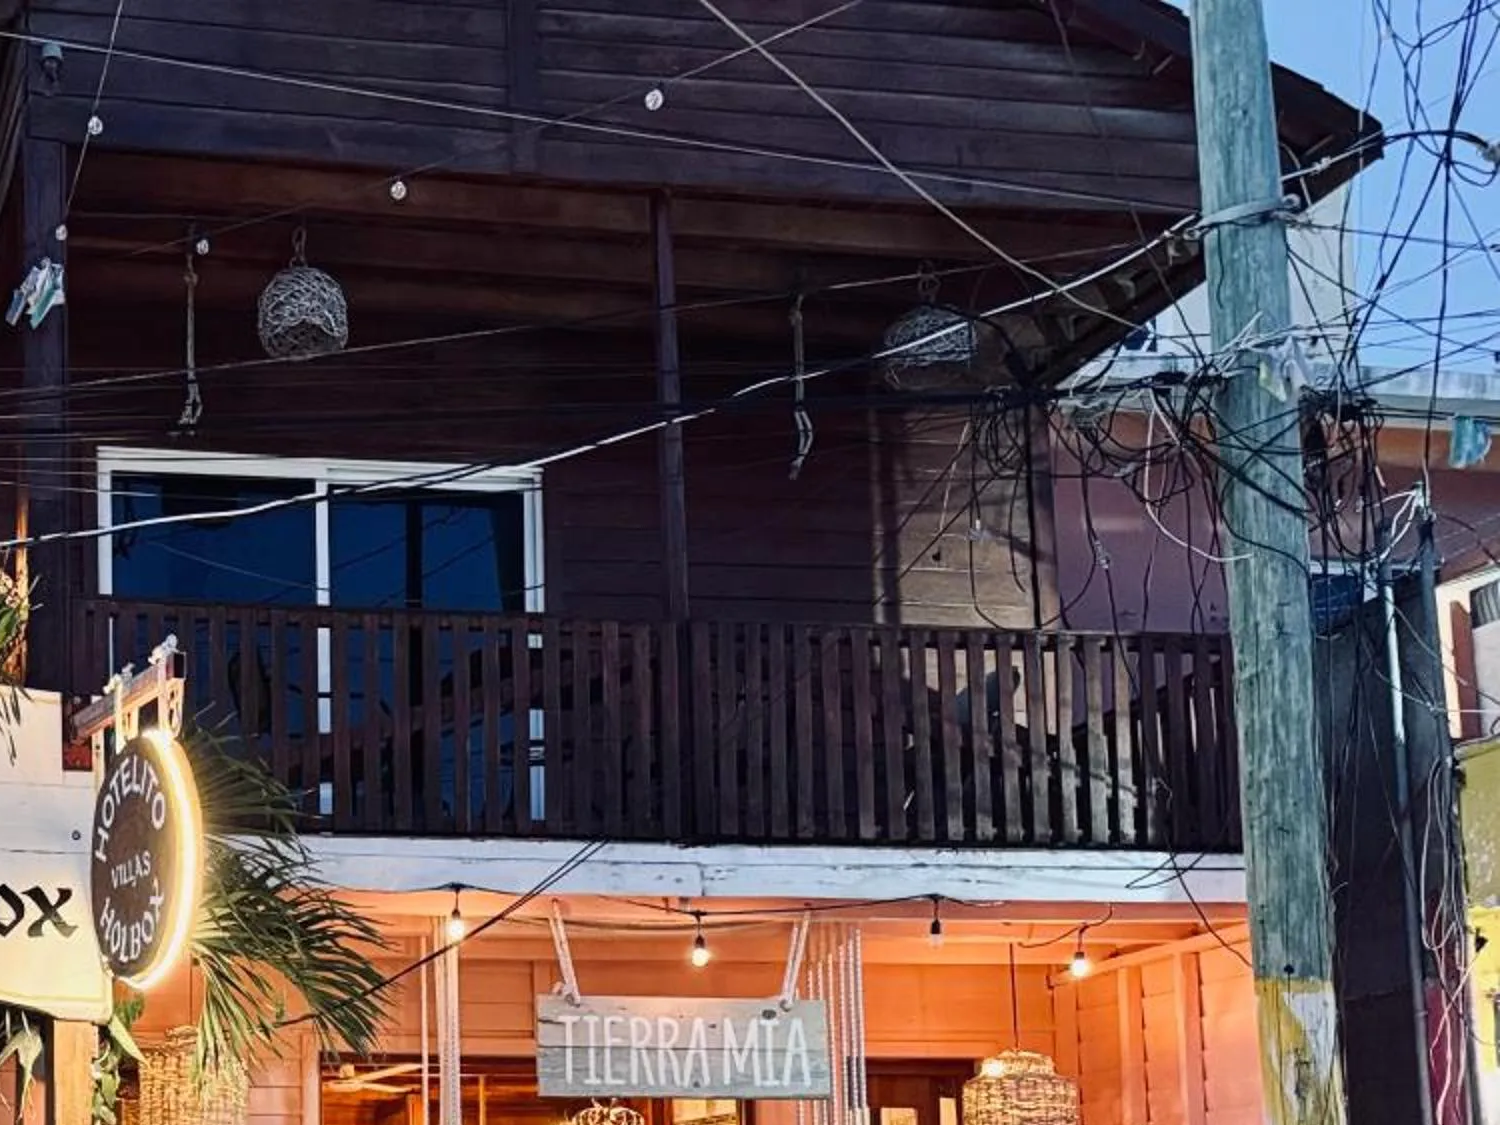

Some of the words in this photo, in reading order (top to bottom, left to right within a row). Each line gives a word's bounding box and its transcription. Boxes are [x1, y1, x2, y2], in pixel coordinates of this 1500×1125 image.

[94, 754, 166, 863] HOTELITO
[111, 850, 152, 889] VILLAS
[100, 878, 164, 963] HOLBOX
[557, 1014, 711, 1088] TIERRA
